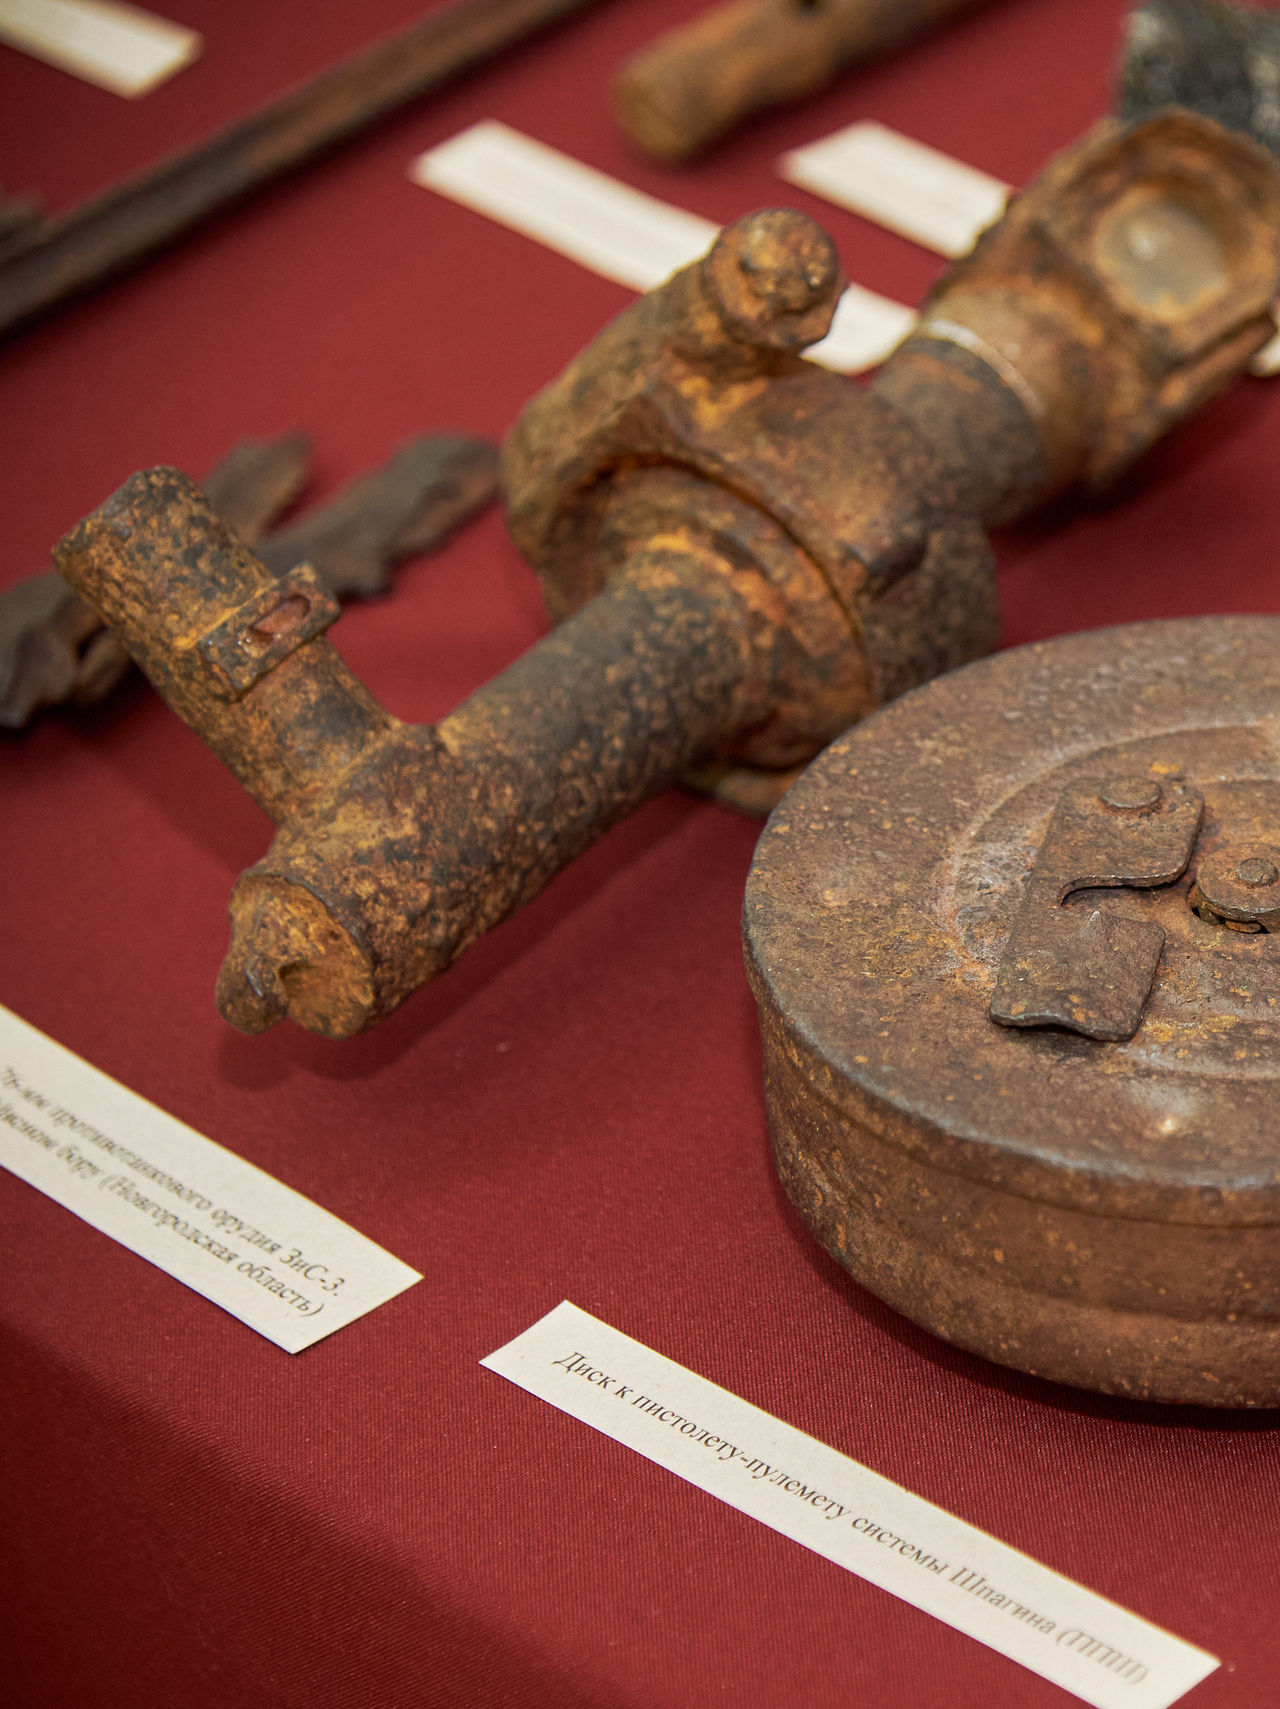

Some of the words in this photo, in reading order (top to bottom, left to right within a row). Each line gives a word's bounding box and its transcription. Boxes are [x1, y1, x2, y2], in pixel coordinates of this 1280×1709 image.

[49, 1103, 213, 1212] противотанкового
[210, 1208, 282, 1255] орудия
[98, 1172, 239, 1264] (Новгородская
[235, 1260, 325, 1317] область)
[550, 1351, 617, 1391] Диск
[613, 1384, 634, 1400] к
[631, 1394, 852, 1520] пистолету-пулемету
[850, 1516, 950, 1576] системы
[948, 1566, 1057, 1636] Шпагина
[1055, 1628, 1150, 1687] (ППШ)
